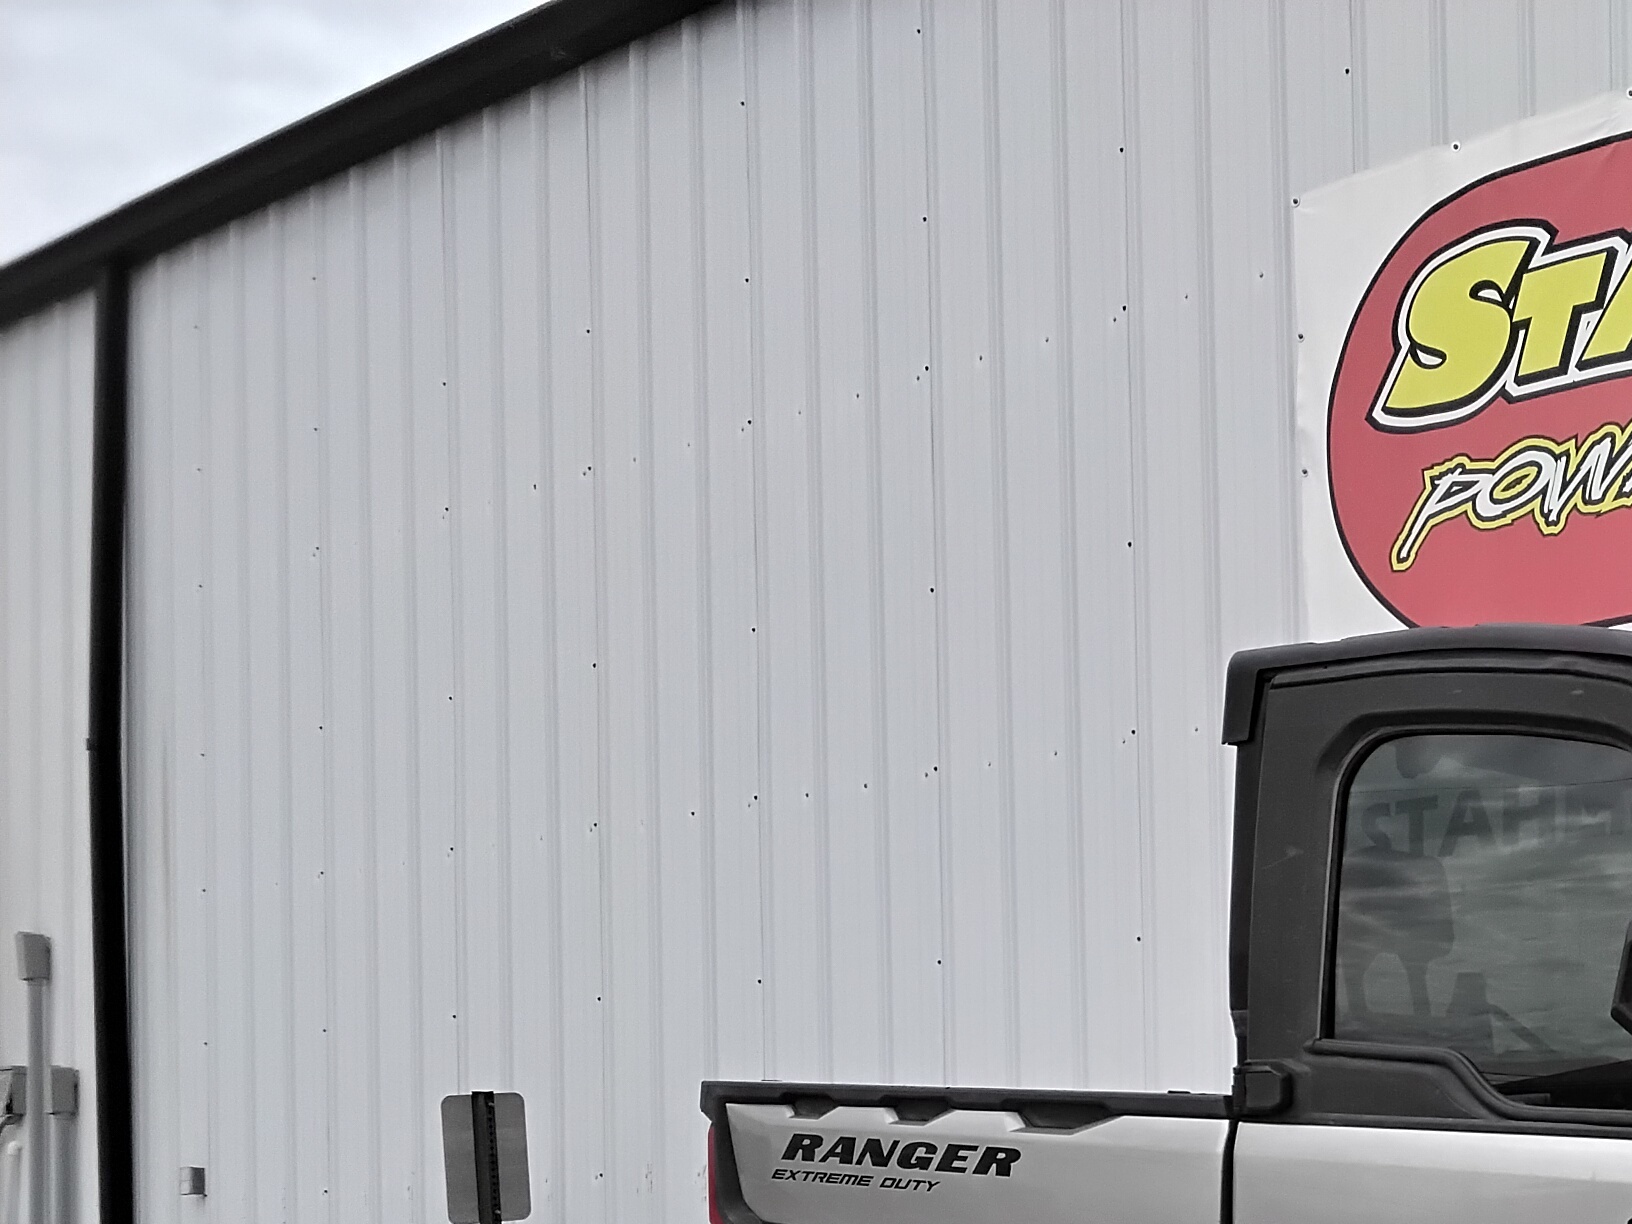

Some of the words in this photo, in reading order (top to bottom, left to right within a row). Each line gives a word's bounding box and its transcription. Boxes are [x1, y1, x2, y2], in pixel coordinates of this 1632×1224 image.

[781, 1132, 1022, 1177] RANGER
[771, 1168, 874, 1187] EXTREME
[879, 1177, 940, 1193] DUTY
